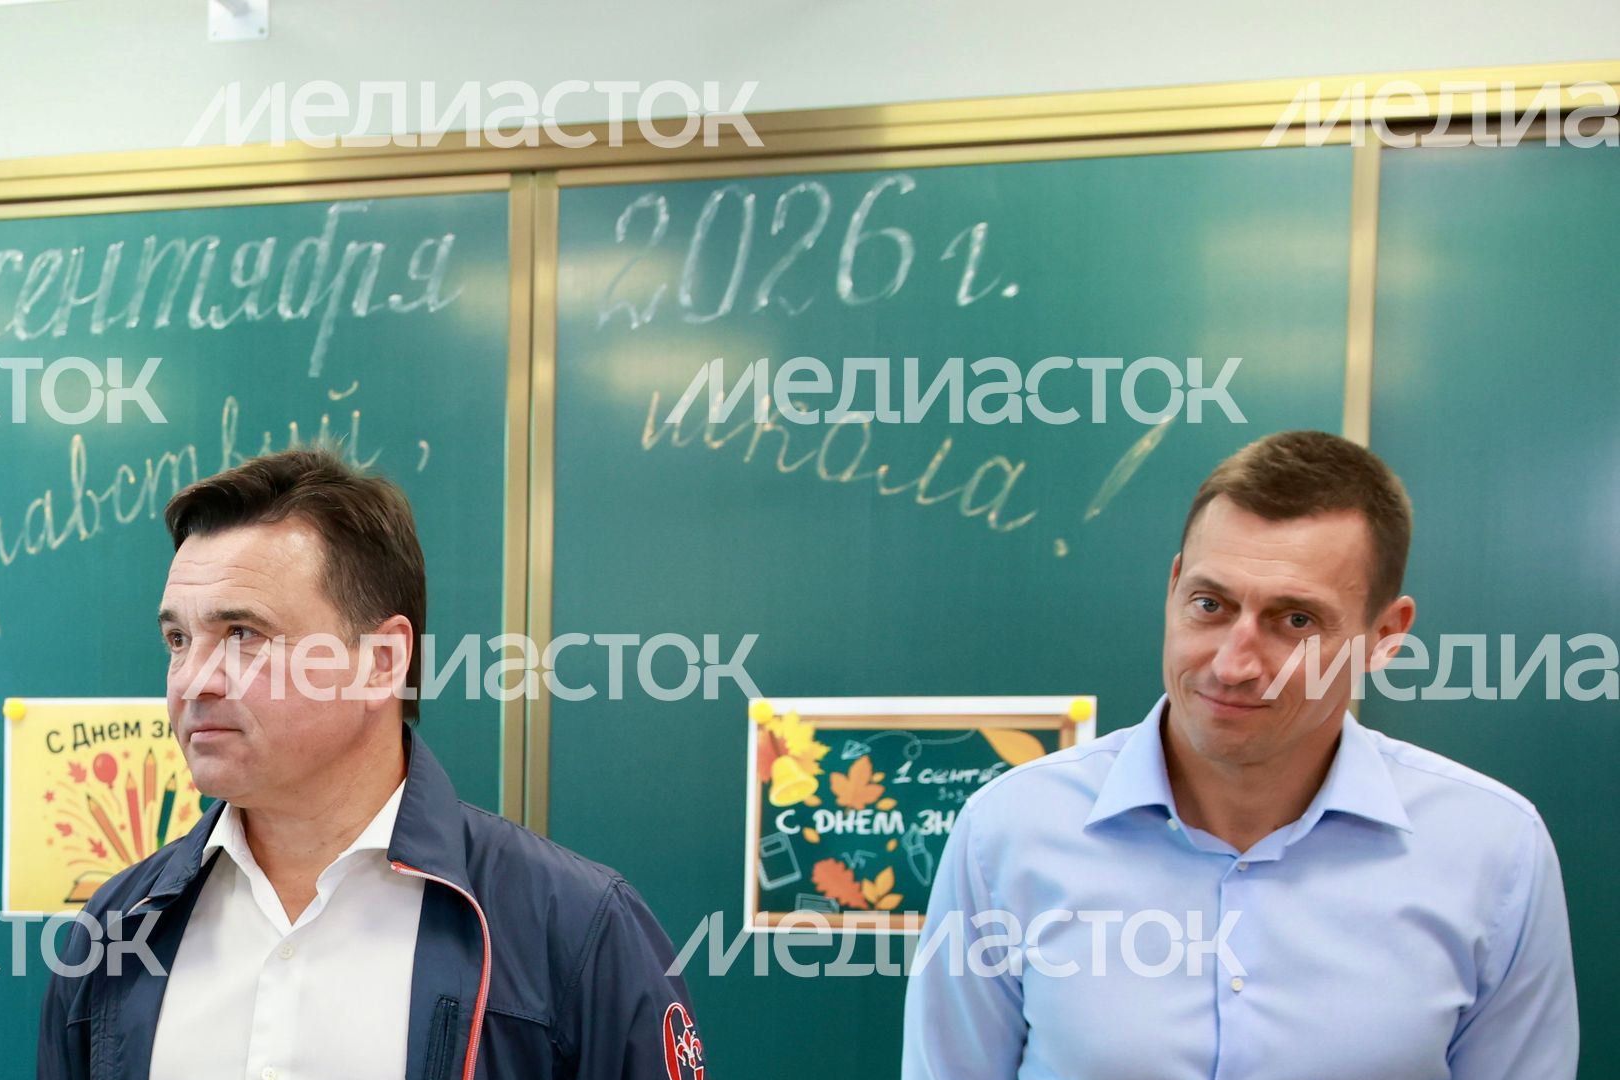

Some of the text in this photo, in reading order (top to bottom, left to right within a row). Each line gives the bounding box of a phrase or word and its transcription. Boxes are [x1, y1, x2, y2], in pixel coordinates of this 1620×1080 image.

[597, 174, 915, 330] 2026
[46, 731, 64, 754] С
[72, 720, 142, 752] Днем
[892, 761, 913, 784] 1
[776, 810, 800, 835] С
[814, 809, 904, 836] ДНЕМ
